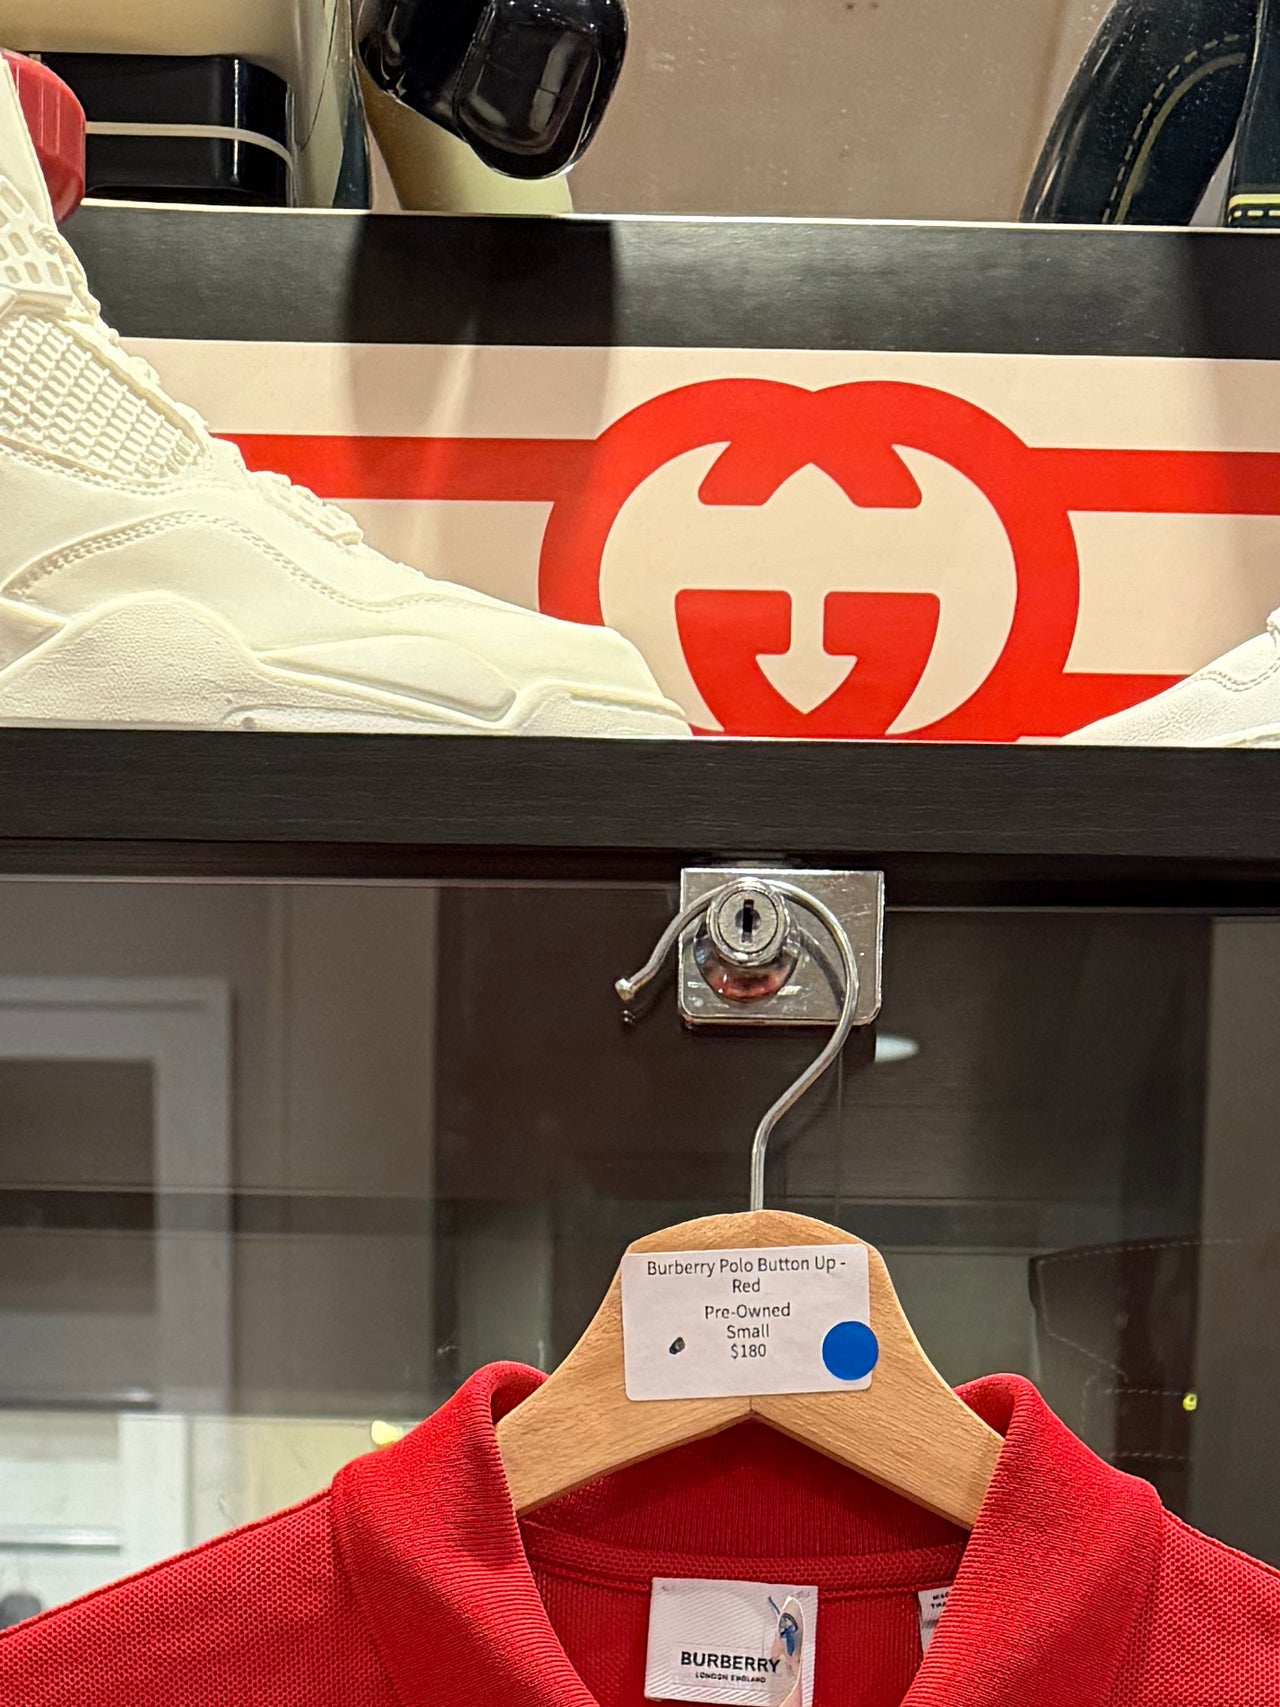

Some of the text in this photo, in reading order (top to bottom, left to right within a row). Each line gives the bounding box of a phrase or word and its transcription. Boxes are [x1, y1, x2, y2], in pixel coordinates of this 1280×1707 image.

[646, 1260, 714, 1277] Burberry
[719, 1257, 753, 1273] Polo
[758, 1256, 810, 1272] Button
[814, 1255, 837, 1275] Up
[732, 1278, 761, 1294] Red
[704, 1302, 791, 1319] Pre-Owned
[727, 1324, 770, 1339] Small
[730, 1343, 767, 1359] $180
[681, 1651, 781, 1673] BURBERRY
[695, 1671, 729, 1682] LONDON
